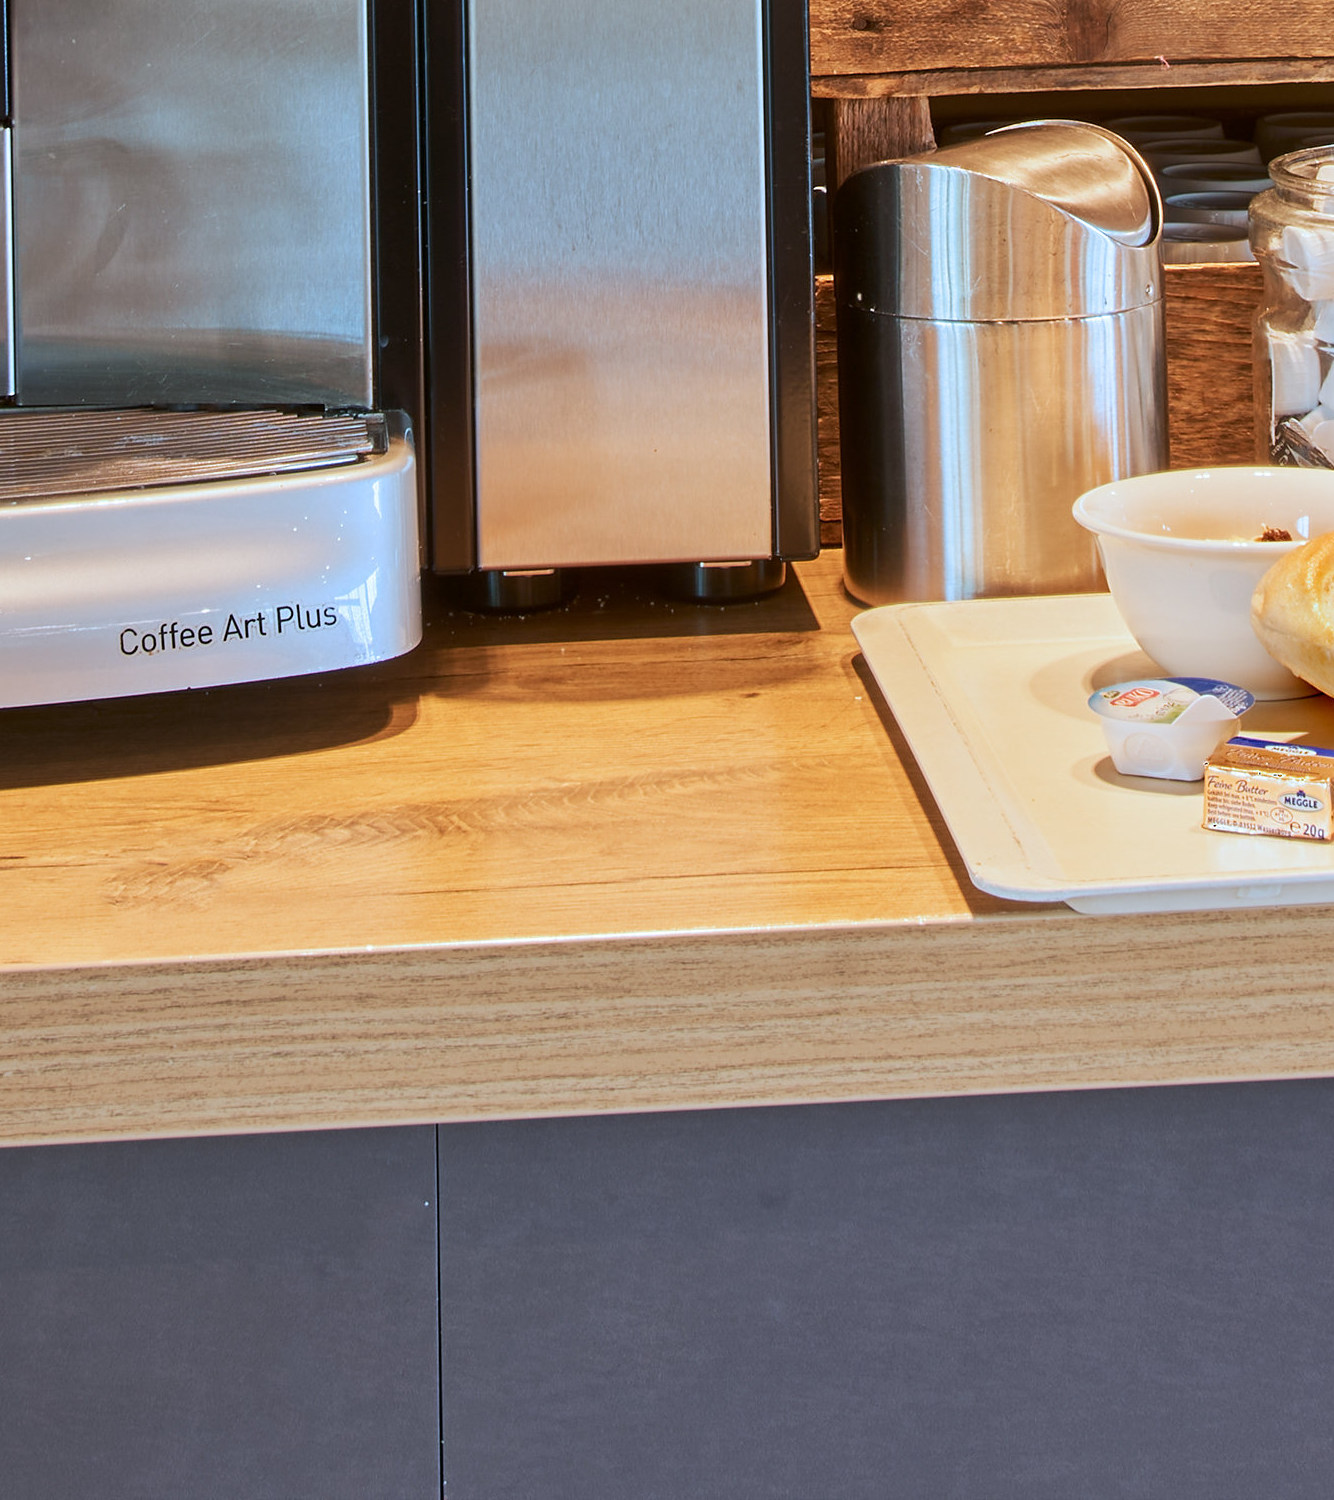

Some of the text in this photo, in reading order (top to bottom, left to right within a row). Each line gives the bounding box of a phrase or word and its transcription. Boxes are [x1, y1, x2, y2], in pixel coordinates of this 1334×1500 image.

[119, 603, 338, 656] Coffee Art Plus
[1207, 775, 1269, 796] Feine Butter
[1284, 796, 1318, 809] MEGGLE
